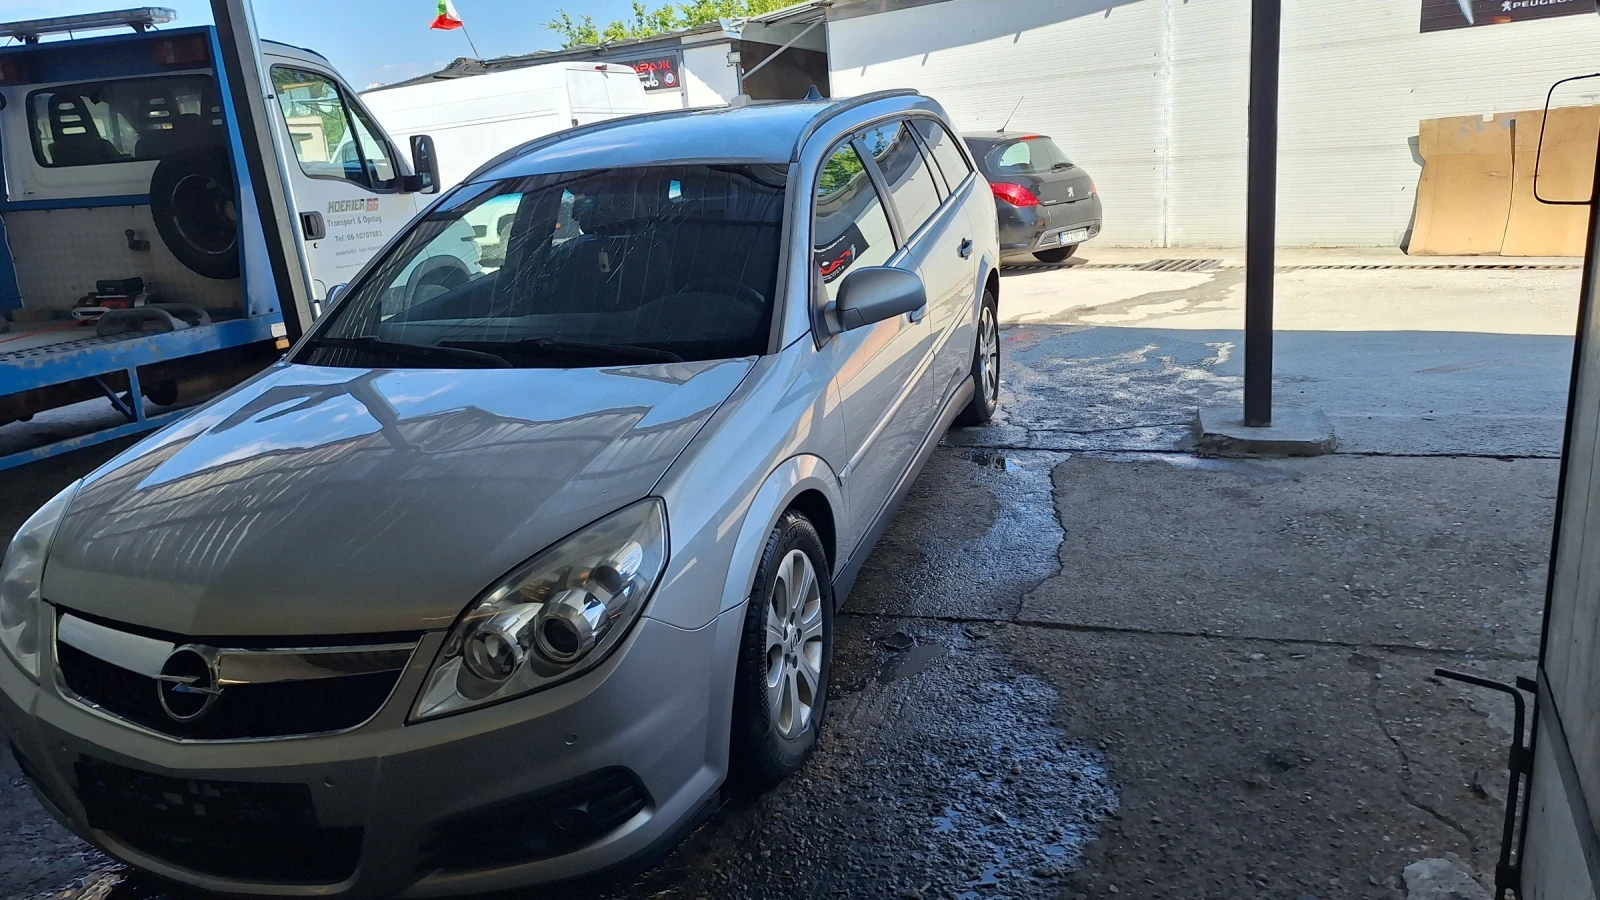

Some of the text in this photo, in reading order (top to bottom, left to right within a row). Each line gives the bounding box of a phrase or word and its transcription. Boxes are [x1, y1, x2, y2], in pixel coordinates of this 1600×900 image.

[328, 199, 364, 213] KOERIER
[327, 215, 382, 227] Transport & Opslag
